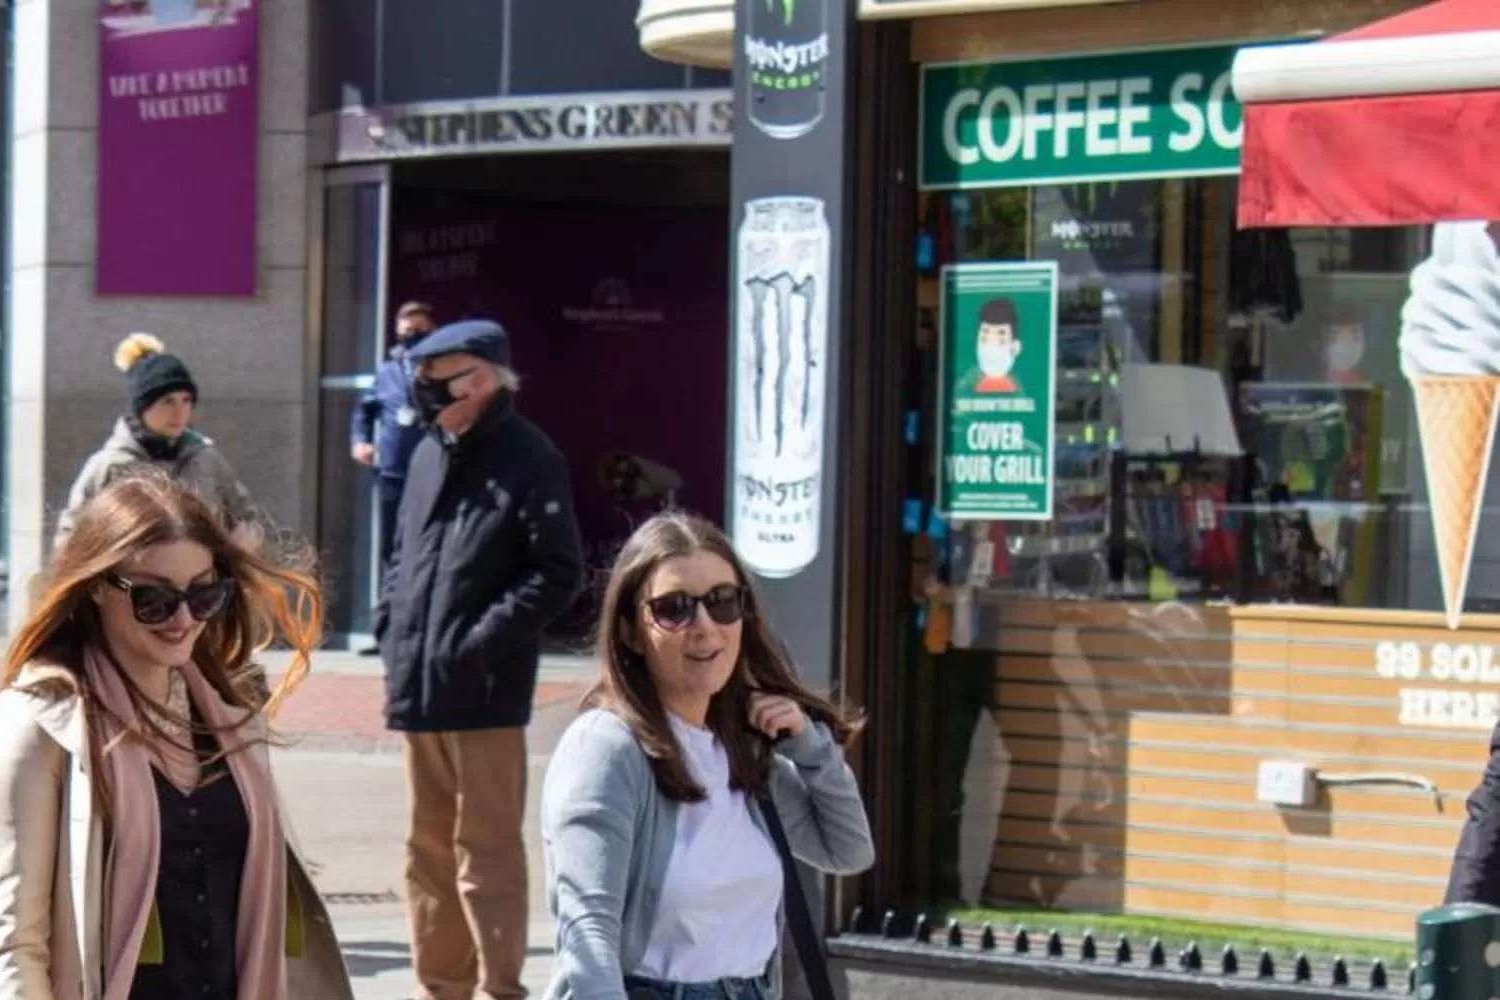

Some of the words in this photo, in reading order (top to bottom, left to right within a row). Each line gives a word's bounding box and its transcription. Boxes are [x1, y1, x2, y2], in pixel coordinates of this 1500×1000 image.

[557, 100, 698, 138] GREEN
[943, 77, 1152, 165] COFFEE
[966, 421, 1025, 452] COVER
[945, 455, 992, 484] YOUR
[994, 455, 1045, 485] GRILL
[1375, 641, 1421, 680] 99
[1398, 688, 1500, 728] HERE
